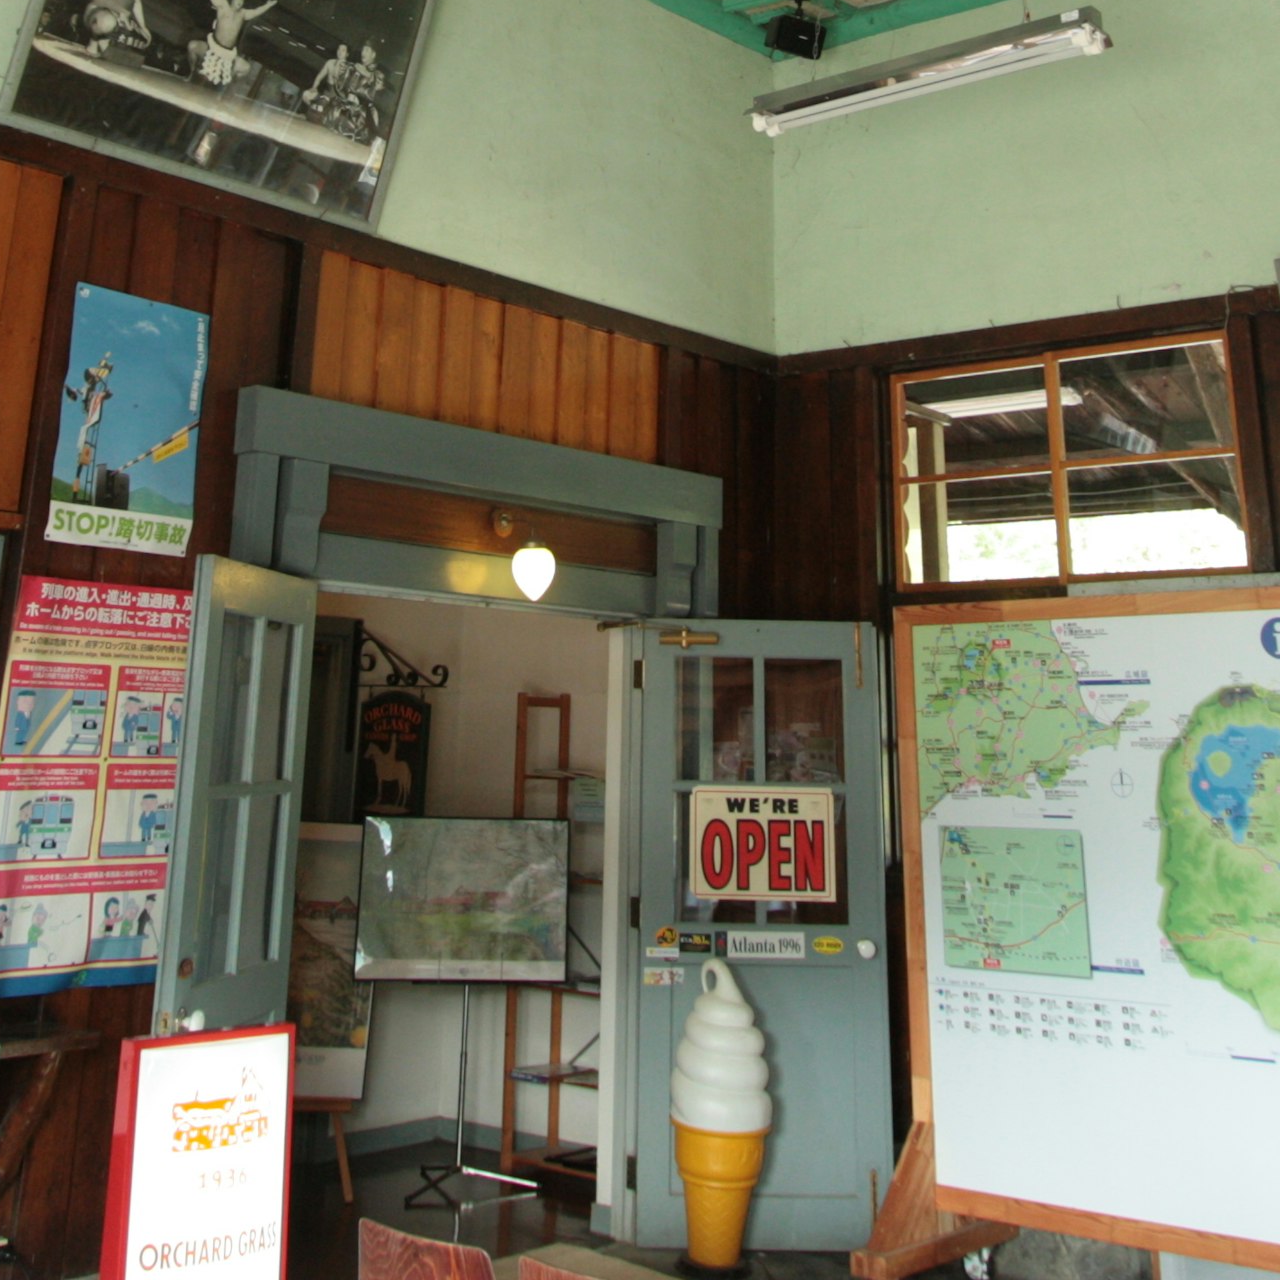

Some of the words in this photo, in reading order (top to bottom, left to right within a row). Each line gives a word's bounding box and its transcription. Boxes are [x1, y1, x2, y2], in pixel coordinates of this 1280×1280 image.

[725, 797, 800, 815] WE'RE
[700, 818, 827, 892] OPEN
[729, 936, 776, 954] Atlanta
[778, 938, 802, 954] 1996
[139, 1234, 234, 1272] ORCHARD
[238, 1221, 277, 1257] GRASS
